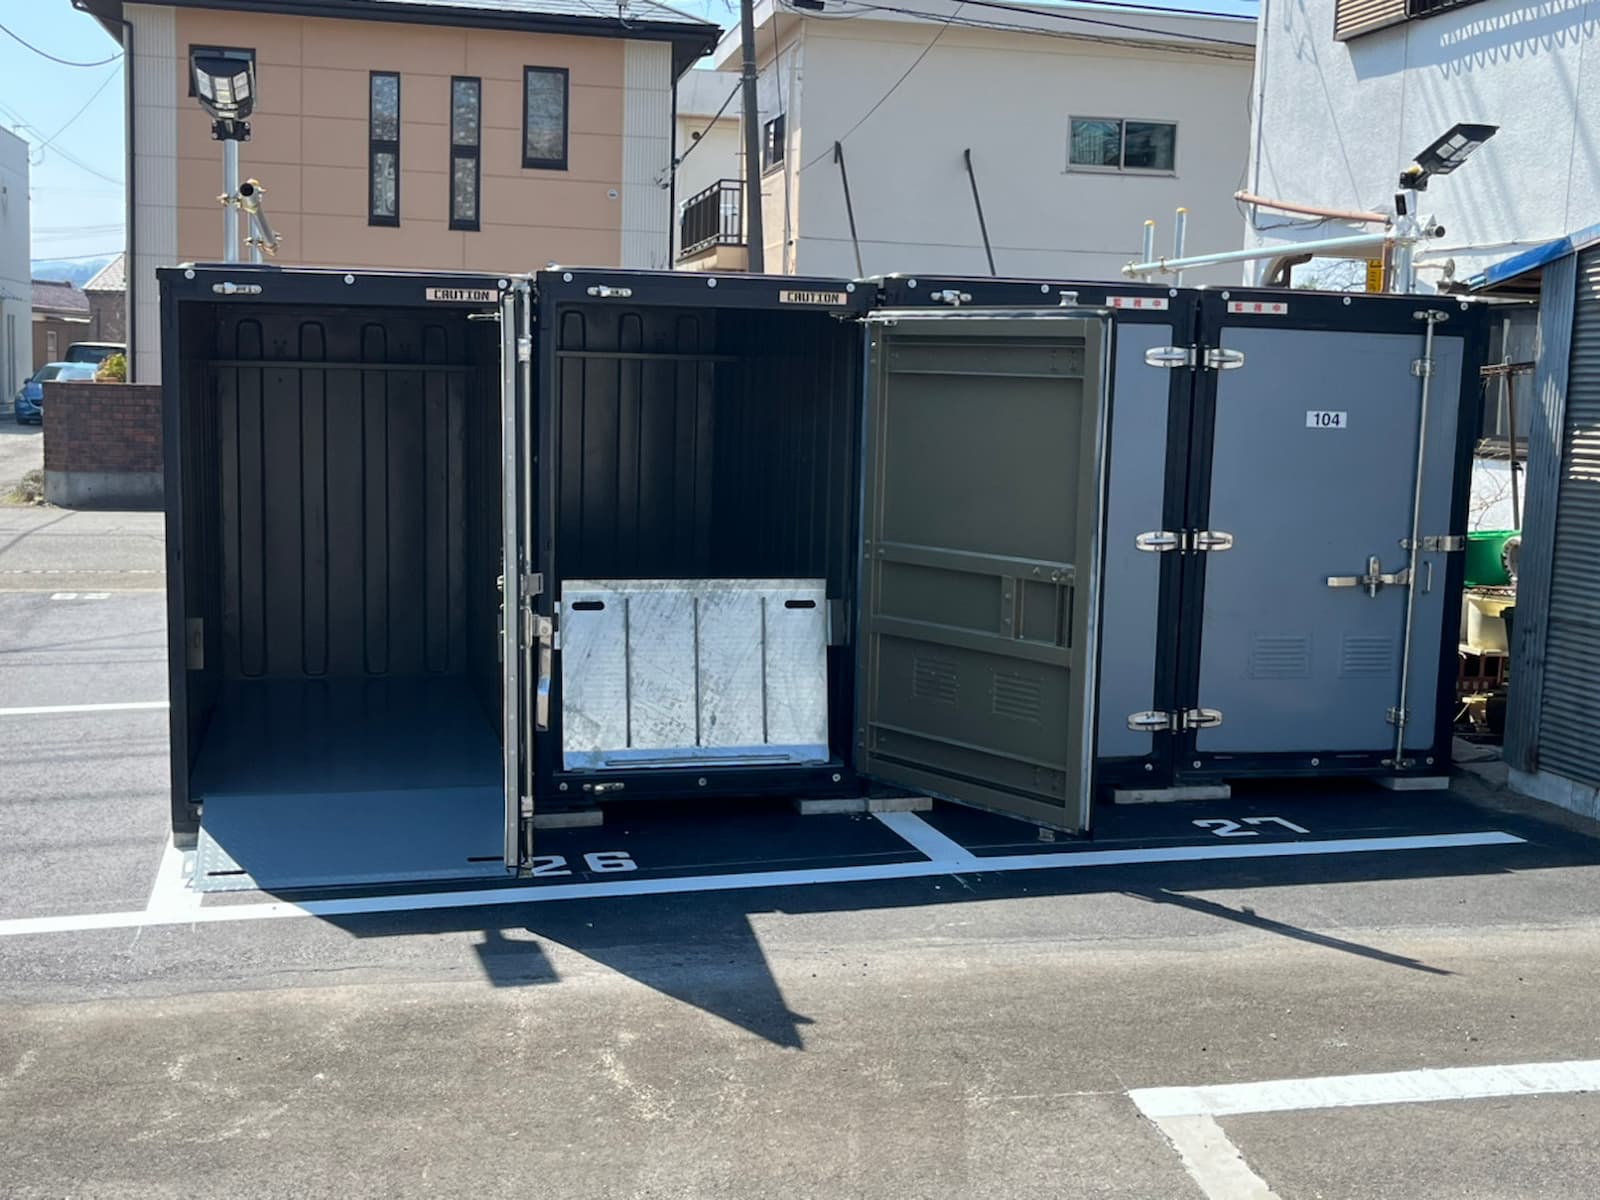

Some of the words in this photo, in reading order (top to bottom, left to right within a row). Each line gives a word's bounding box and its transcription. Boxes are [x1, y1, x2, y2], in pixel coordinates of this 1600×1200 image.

[434, 289, 490, 301] CAUTION
[787, 291, 840, 304] CAUTION
[1313, 412, 1340, 427] 104
[1191, 816, 1311, 838] 27
[531, 851, 639, 878] 26
